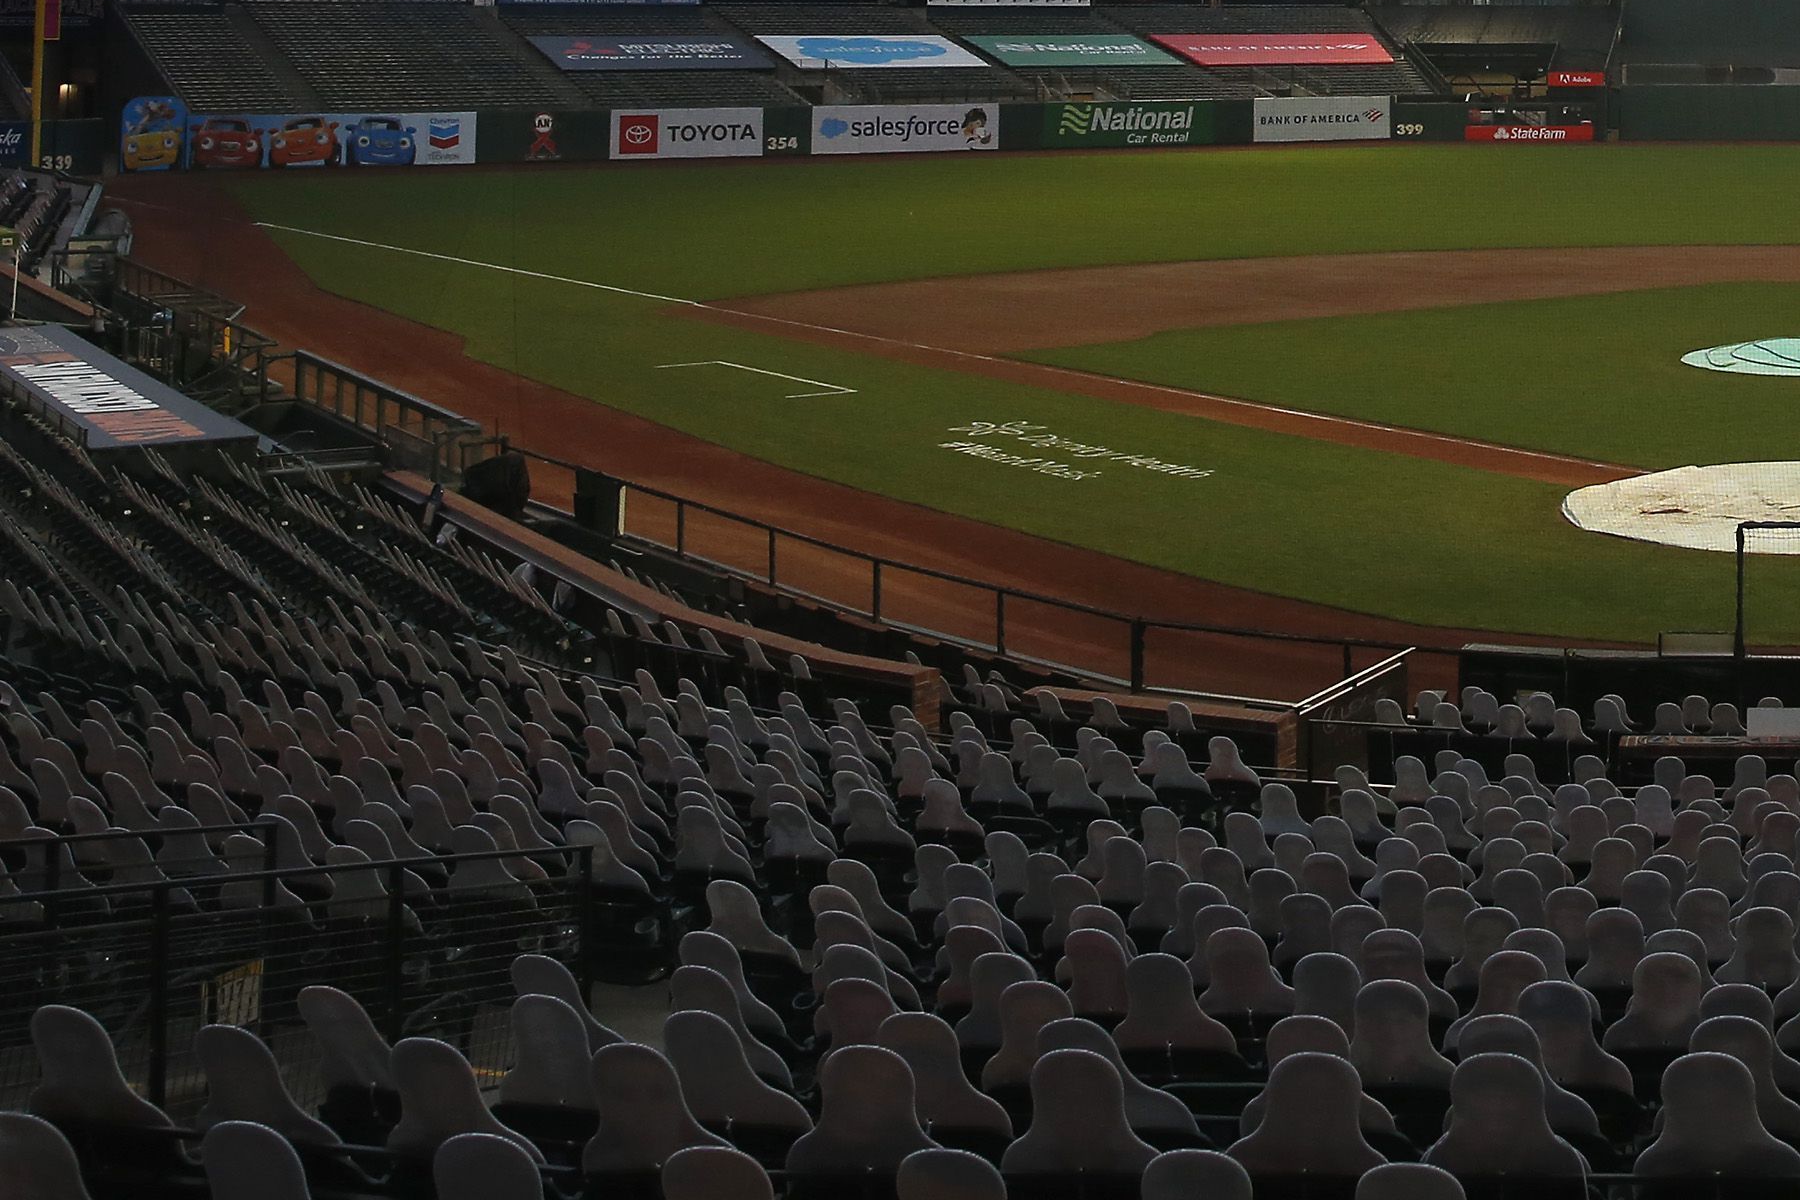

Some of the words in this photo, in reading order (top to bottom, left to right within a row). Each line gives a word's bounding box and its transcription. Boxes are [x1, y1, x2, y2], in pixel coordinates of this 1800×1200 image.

[1090, 106, 1194, 132] National
[1260, 116, 1290, 125] BANK
[1294, 115, 1306, 124] OF
[1310, 114, 1360, 123] AMERICA
[667, 124, 756, 142] TOYOTA
[851, 115, 959, 141] salesforce
[1396, 124, 1424, 135] 399
[767, 137, 798, 150] 354
[1127, 133, 1146, 144] Car
[1150, 132, 1189, 143] Rental
[41, 155, 73, 170] 339
